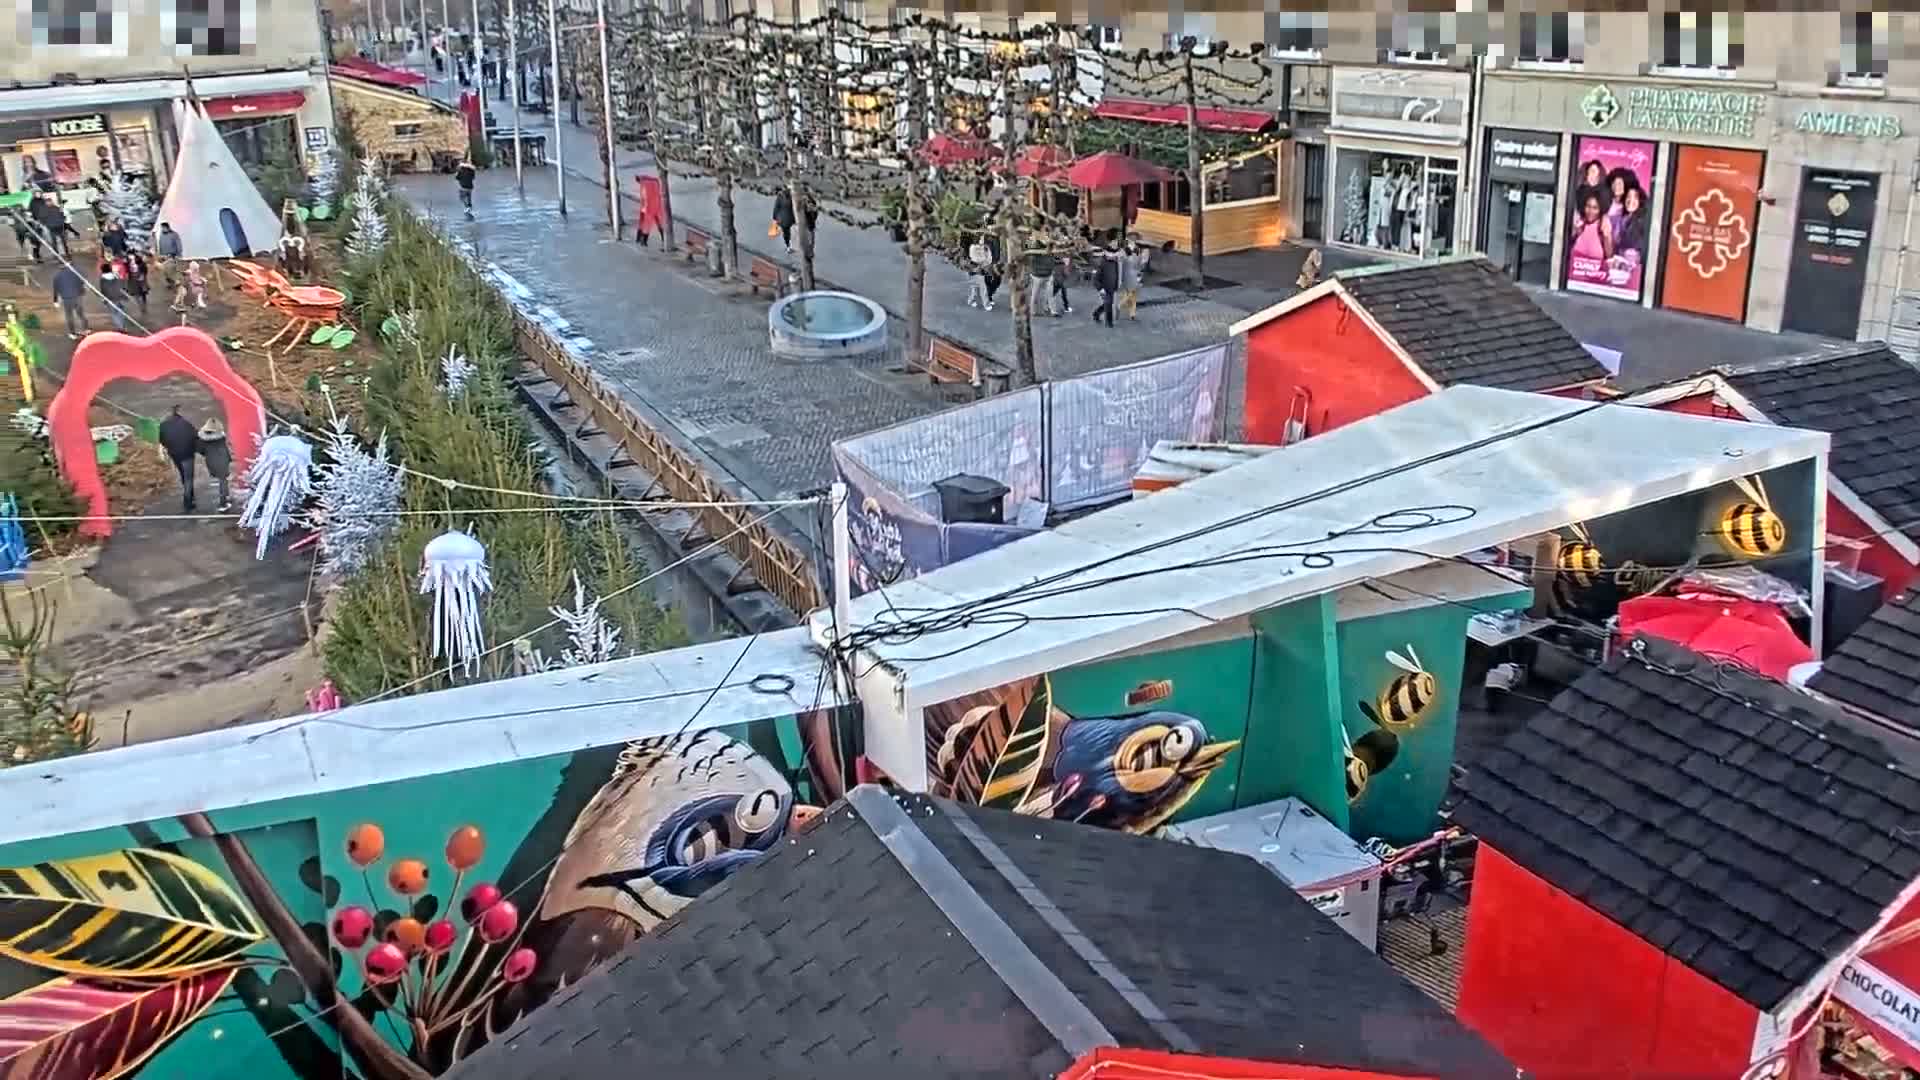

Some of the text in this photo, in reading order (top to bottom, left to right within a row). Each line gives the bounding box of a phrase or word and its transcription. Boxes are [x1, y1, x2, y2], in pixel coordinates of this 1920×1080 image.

[1630, 87, 1766, 116] PHARMACIE
[1628, 109, 1754, 138] LAFAYETTE
[1795, 111, 1903, 138] AMIENS
